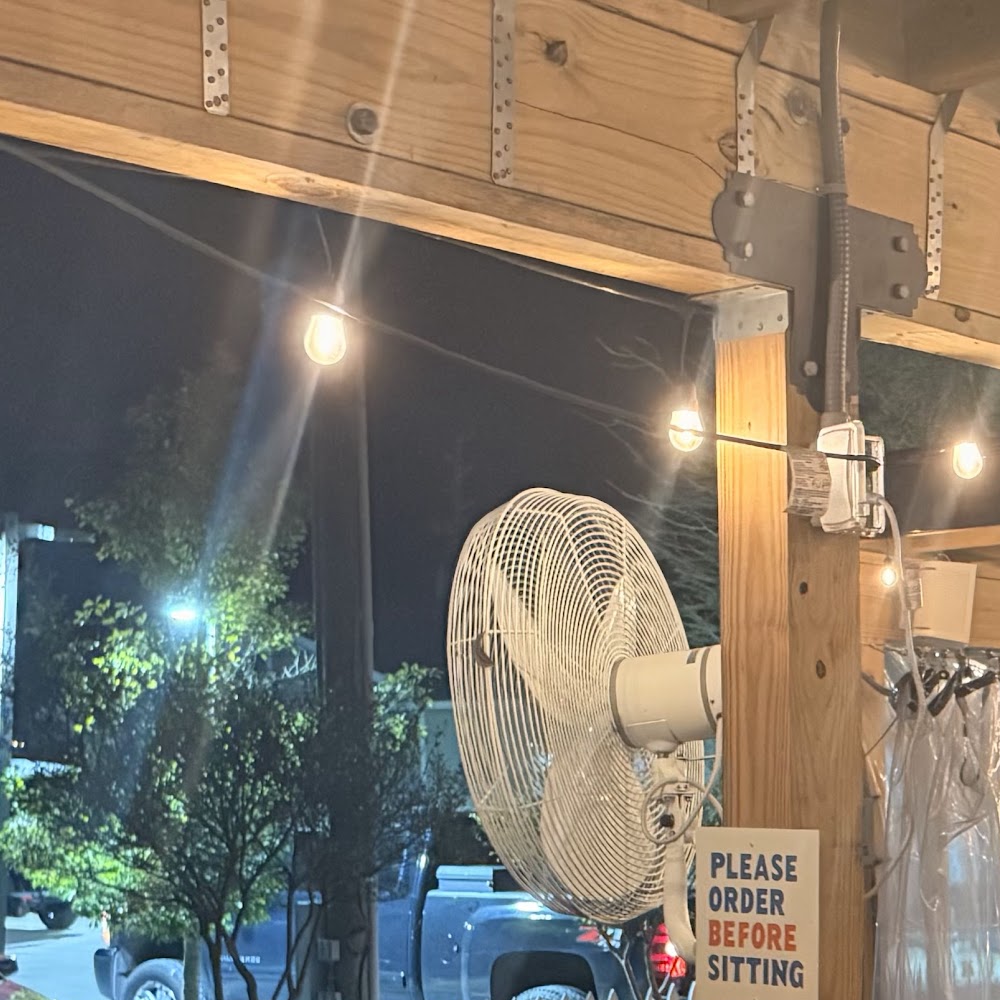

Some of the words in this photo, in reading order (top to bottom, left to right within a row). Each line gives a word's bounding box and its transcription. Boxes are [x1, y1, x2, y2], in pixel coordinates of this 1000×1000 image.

[710, 852, 798, 882] PLEASE
[708, 886, 785, 915] ORDER
[708, 919, 798, 951] BEFORE
[708, 955, 804, 989] SITTING
